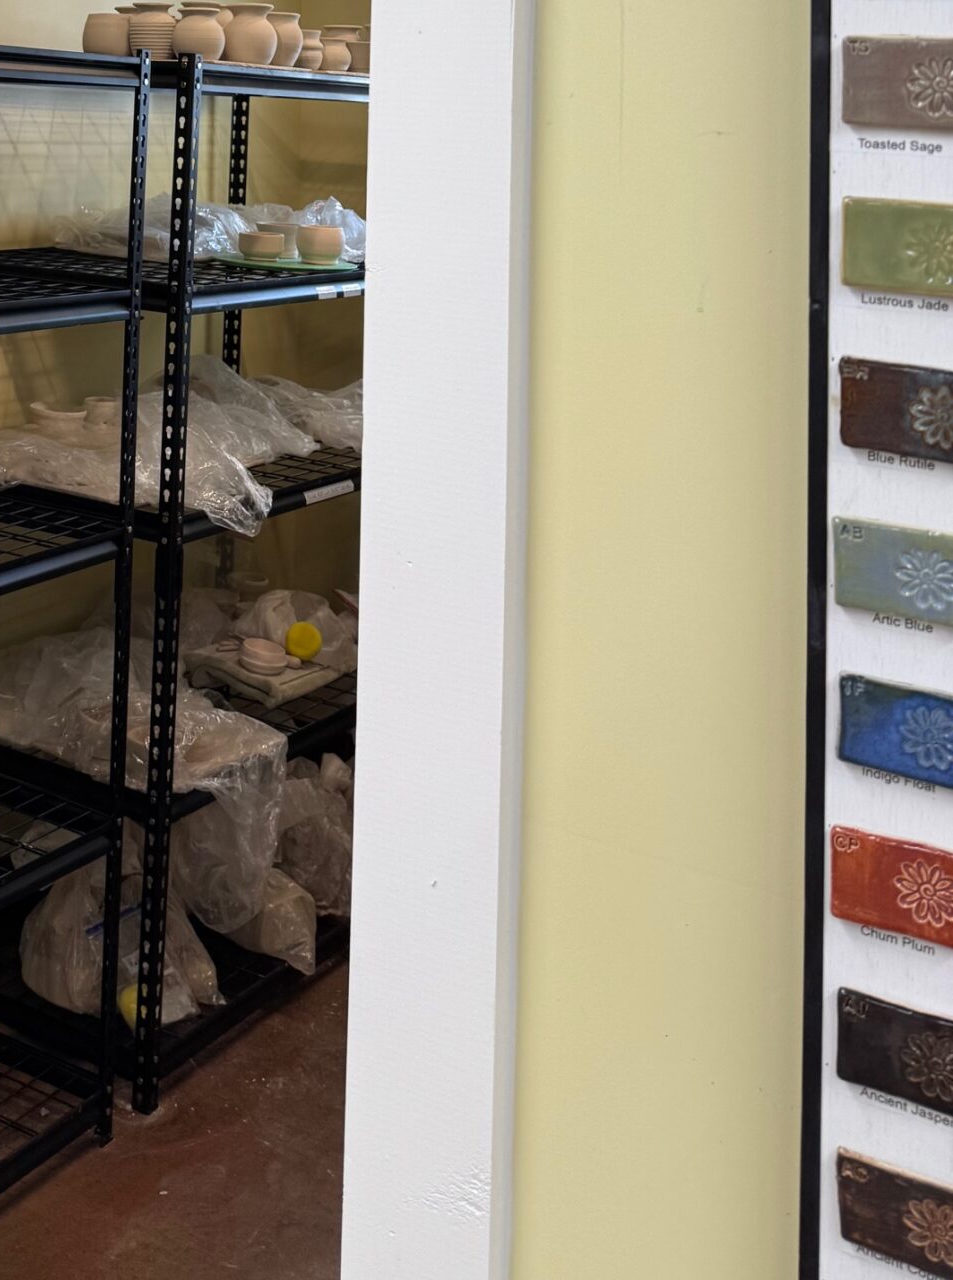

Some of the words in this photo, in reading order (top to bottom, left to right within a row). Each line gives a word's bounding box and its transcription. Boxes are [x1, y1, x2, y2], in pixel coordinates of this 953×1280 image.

[858, 137, 906, 151] Toasted
[910, 139, 943, 153] Sage
[861, 293, 914, 309] Lustrous
[917, 300, 949, 312] Jade
[867, 450, 895, 464] Blue
[898, 456, 935, 471] Rutile
[872, 612, 901, 626] Artic
[904, 618, 934, 632] Blue
[862, 767, 900, 784] Indigo
[904, 777, 935, 792] Float
[860, 925, 898, 945] Chum
[902, 935, 936, 956] Plum
[860, 1086, 908, 1112] Ancient
[856, 1245, 904, 1270] Ancient
